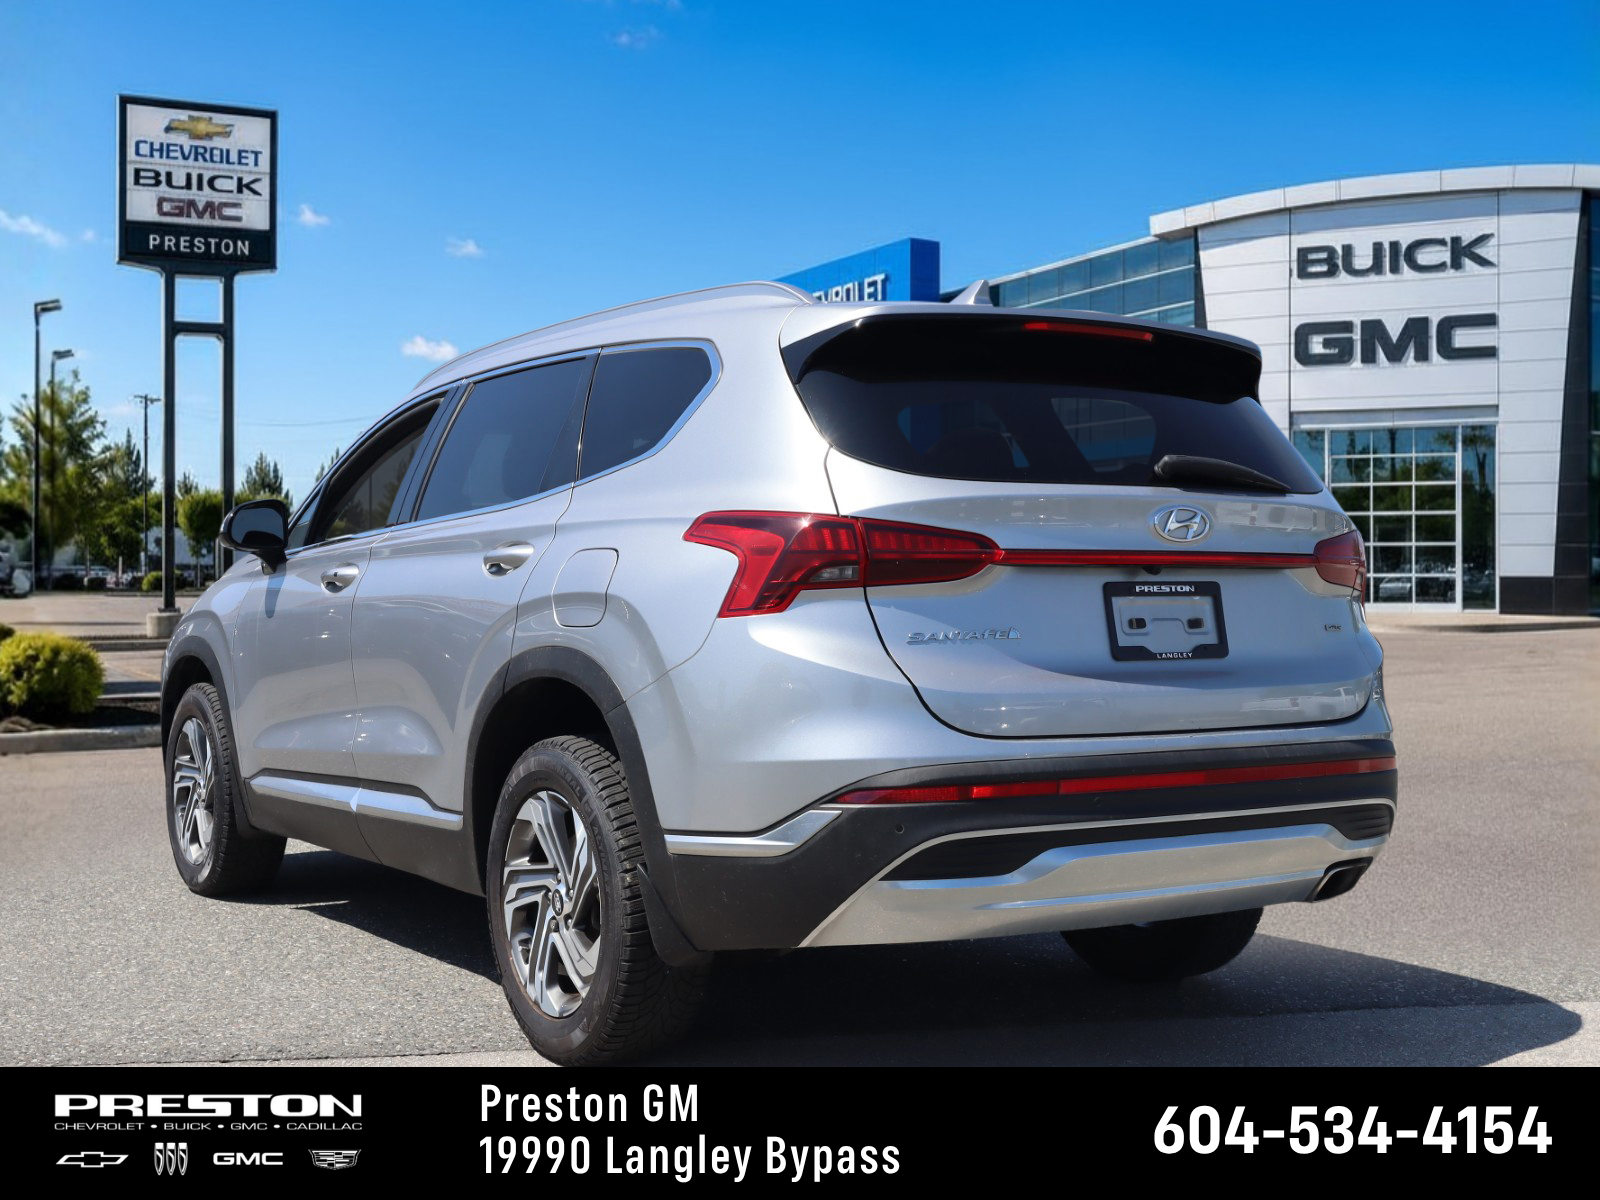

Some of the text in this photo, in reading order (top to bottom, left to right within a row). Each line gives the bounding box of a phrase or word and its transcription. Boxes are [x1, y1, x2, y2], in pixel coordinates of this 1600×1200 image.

[134, 139, 263, 167] CHEVROLET
[133, 167, 263, 197] BUICK
[156, 196, 243, 223] GMC
[148, 233, 250, 256] PRESTON
[1297, 232, 1497, 280] BUICK
[1294, 312, 1498, 367] GMC
[1135, 585, 1195, 593] PRESTON
